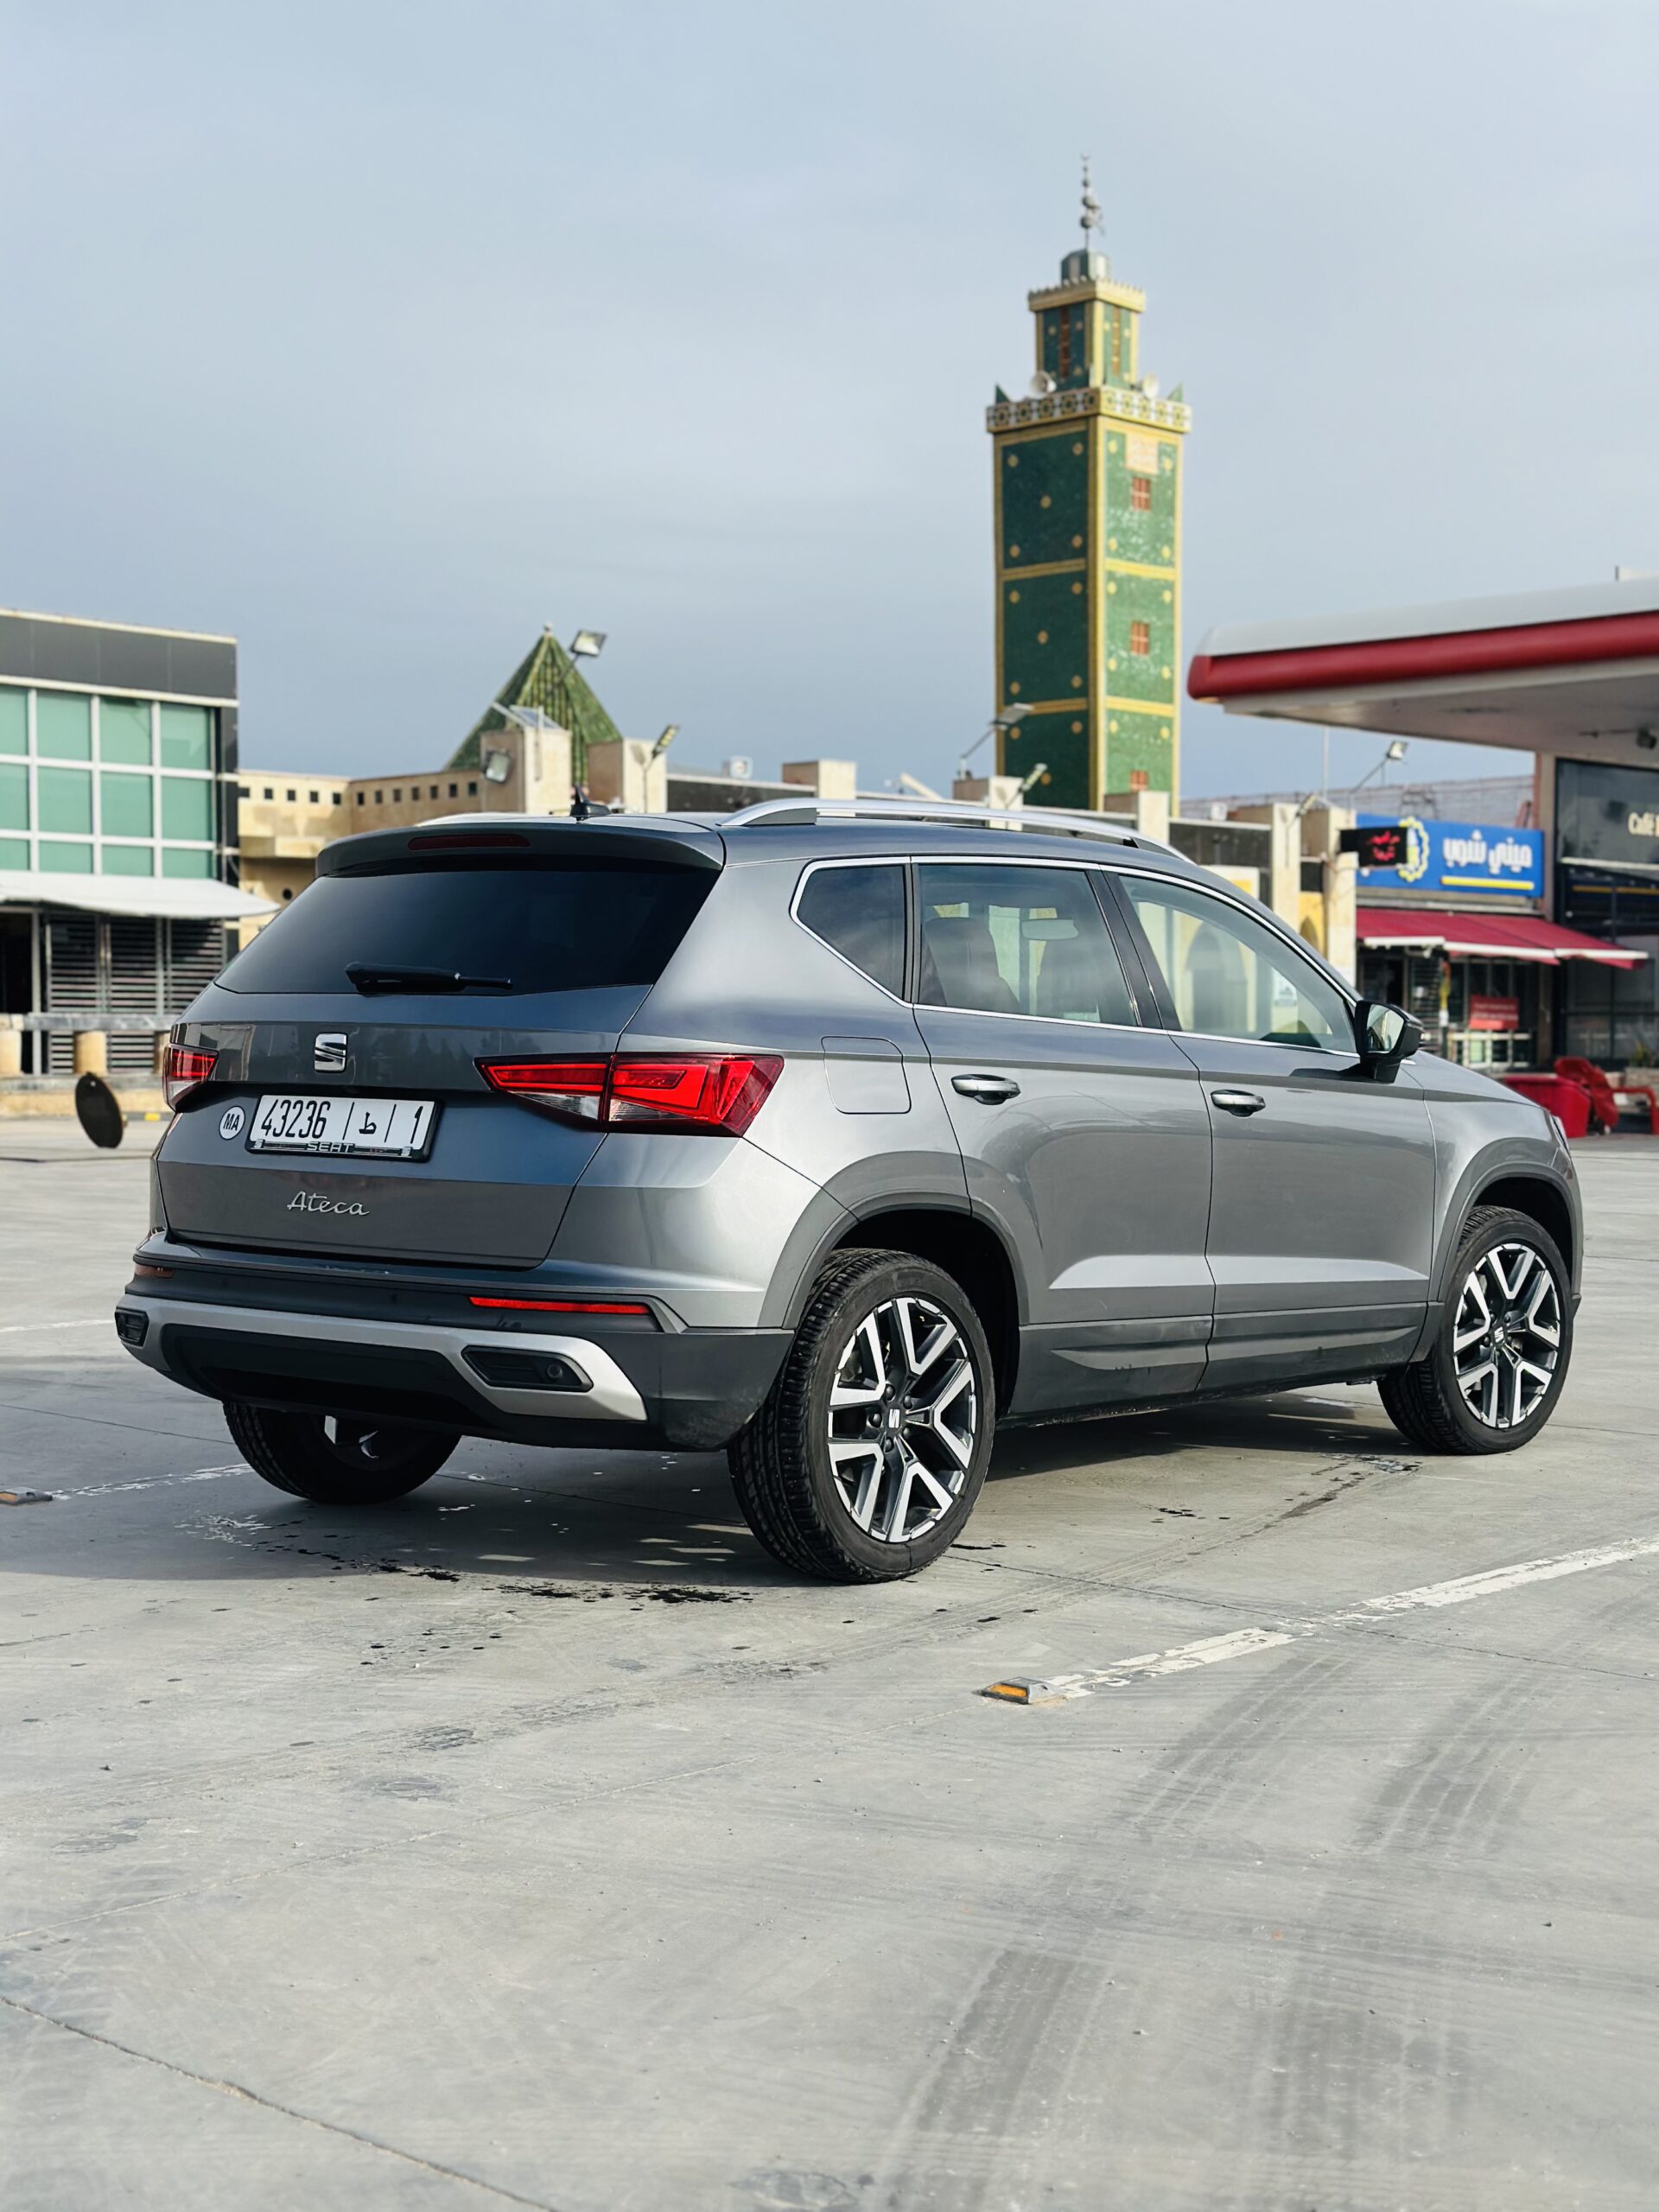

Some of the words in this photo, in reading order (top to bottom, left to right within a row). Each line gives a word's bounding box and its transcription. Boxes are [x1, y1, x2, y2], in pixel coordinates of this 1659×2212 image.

[1489, 836, 1533, 874] ميني
[223, 1113, 239, 1132] MA
[260, 1098, 332, 1140] 43236
[359, 1111, 378, 1135] ط
[306, 1141, 355, 1154] SEAT
[286, 1191, 371, 1216] Ateca
